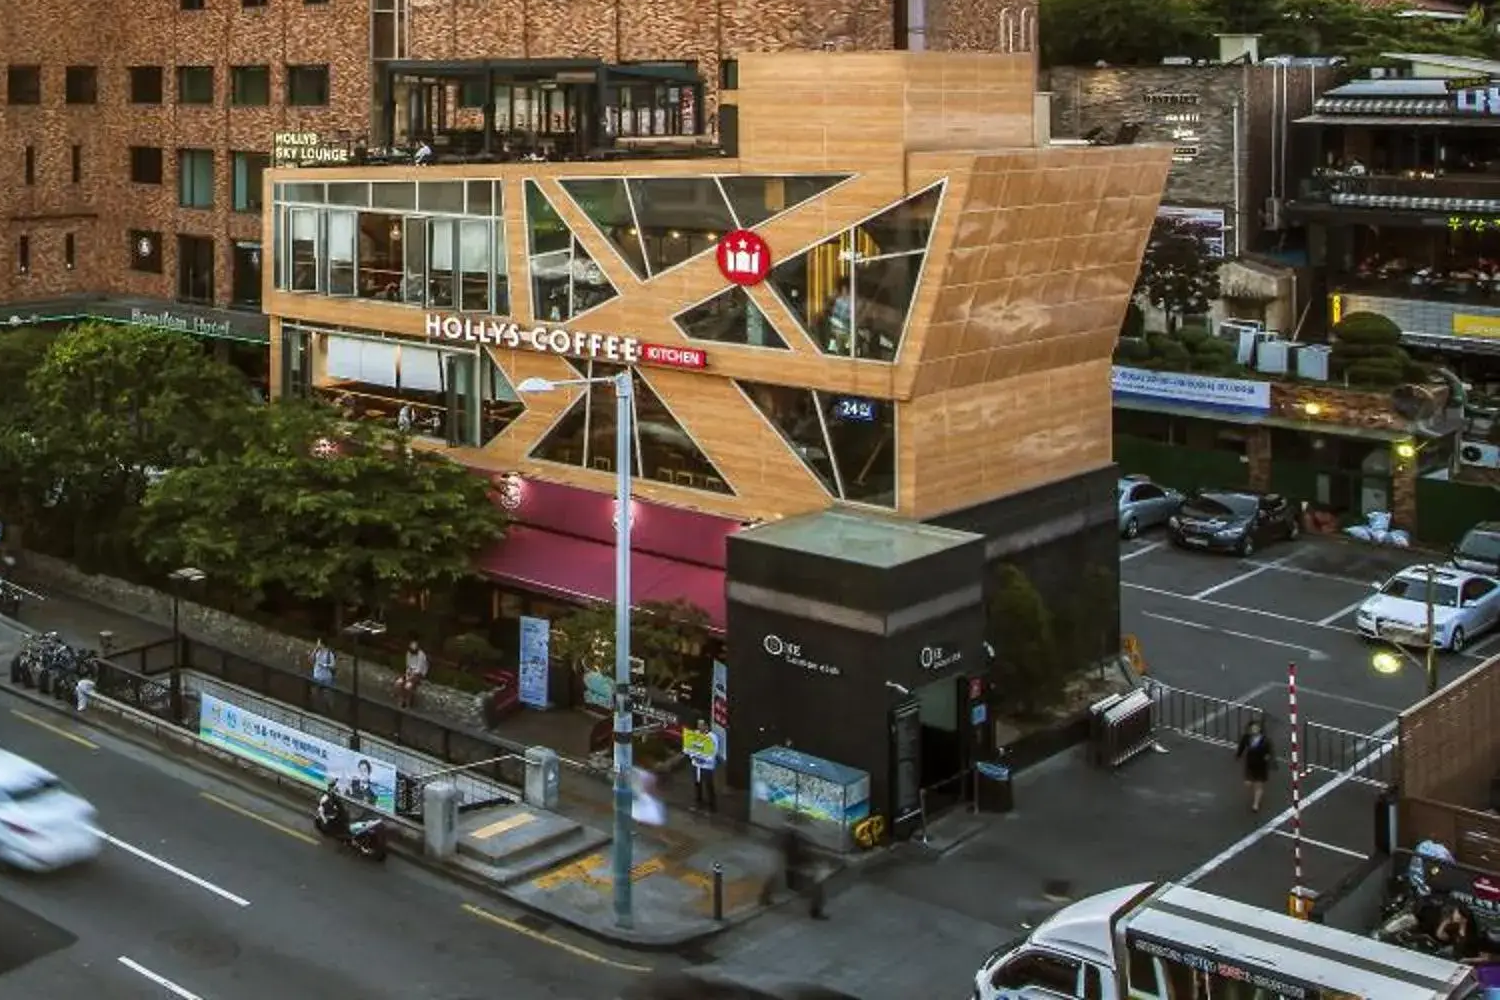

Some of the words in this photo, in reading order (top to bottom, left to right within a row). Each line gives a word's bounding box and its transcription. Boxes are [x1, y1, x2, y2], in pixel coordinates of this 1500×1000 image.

[275, 132, 319, 146] HOLLYS
[275, 146, 298, 159] SKY
[301, 147, 348, 161] LOUNGE
[131, 308, 187, 329] Hamilton
[193, 316, 231, 334] Hotel
[424, 313, 521, 348] HOLLYS
[530, 326, 639, 362] COFFEE
[646, 346, 701, 365] KITCHEN
